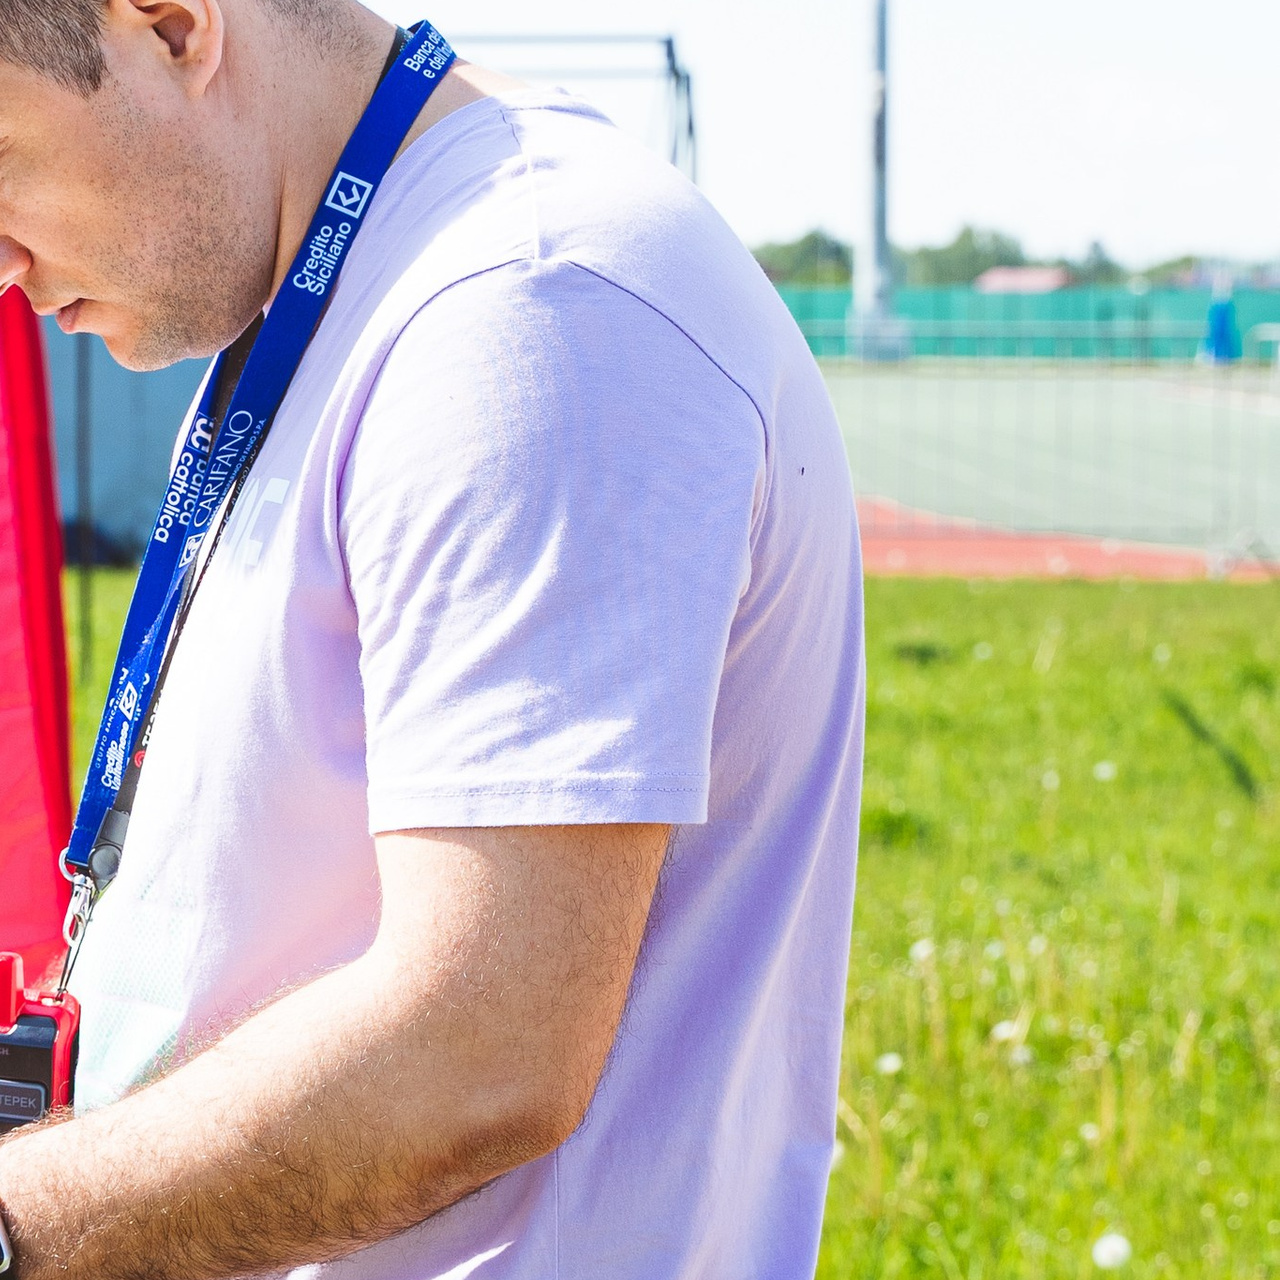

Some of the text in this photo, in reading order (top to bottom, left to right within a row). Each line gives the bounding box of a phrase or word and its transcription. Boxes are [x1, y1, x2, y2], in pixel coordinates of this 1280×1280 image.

[403, 40, 435, 72] Banca
[422, 68, 435, 79] e
[293, 225, 333, 289] Credito
[308, 222, 351, 295] Siciliano
[193, 410, 253, 528] CARIFANO
[243, 436, 256, 455] FANO
[154, 452, 194, 544] cattolica
[95, 734, 108, 769] GRUPPO
[105, 690, 124, 733] BANCARIO
[111, 721, 129, 791] Valtellinese
[101, 740, 117, 787] Credito
